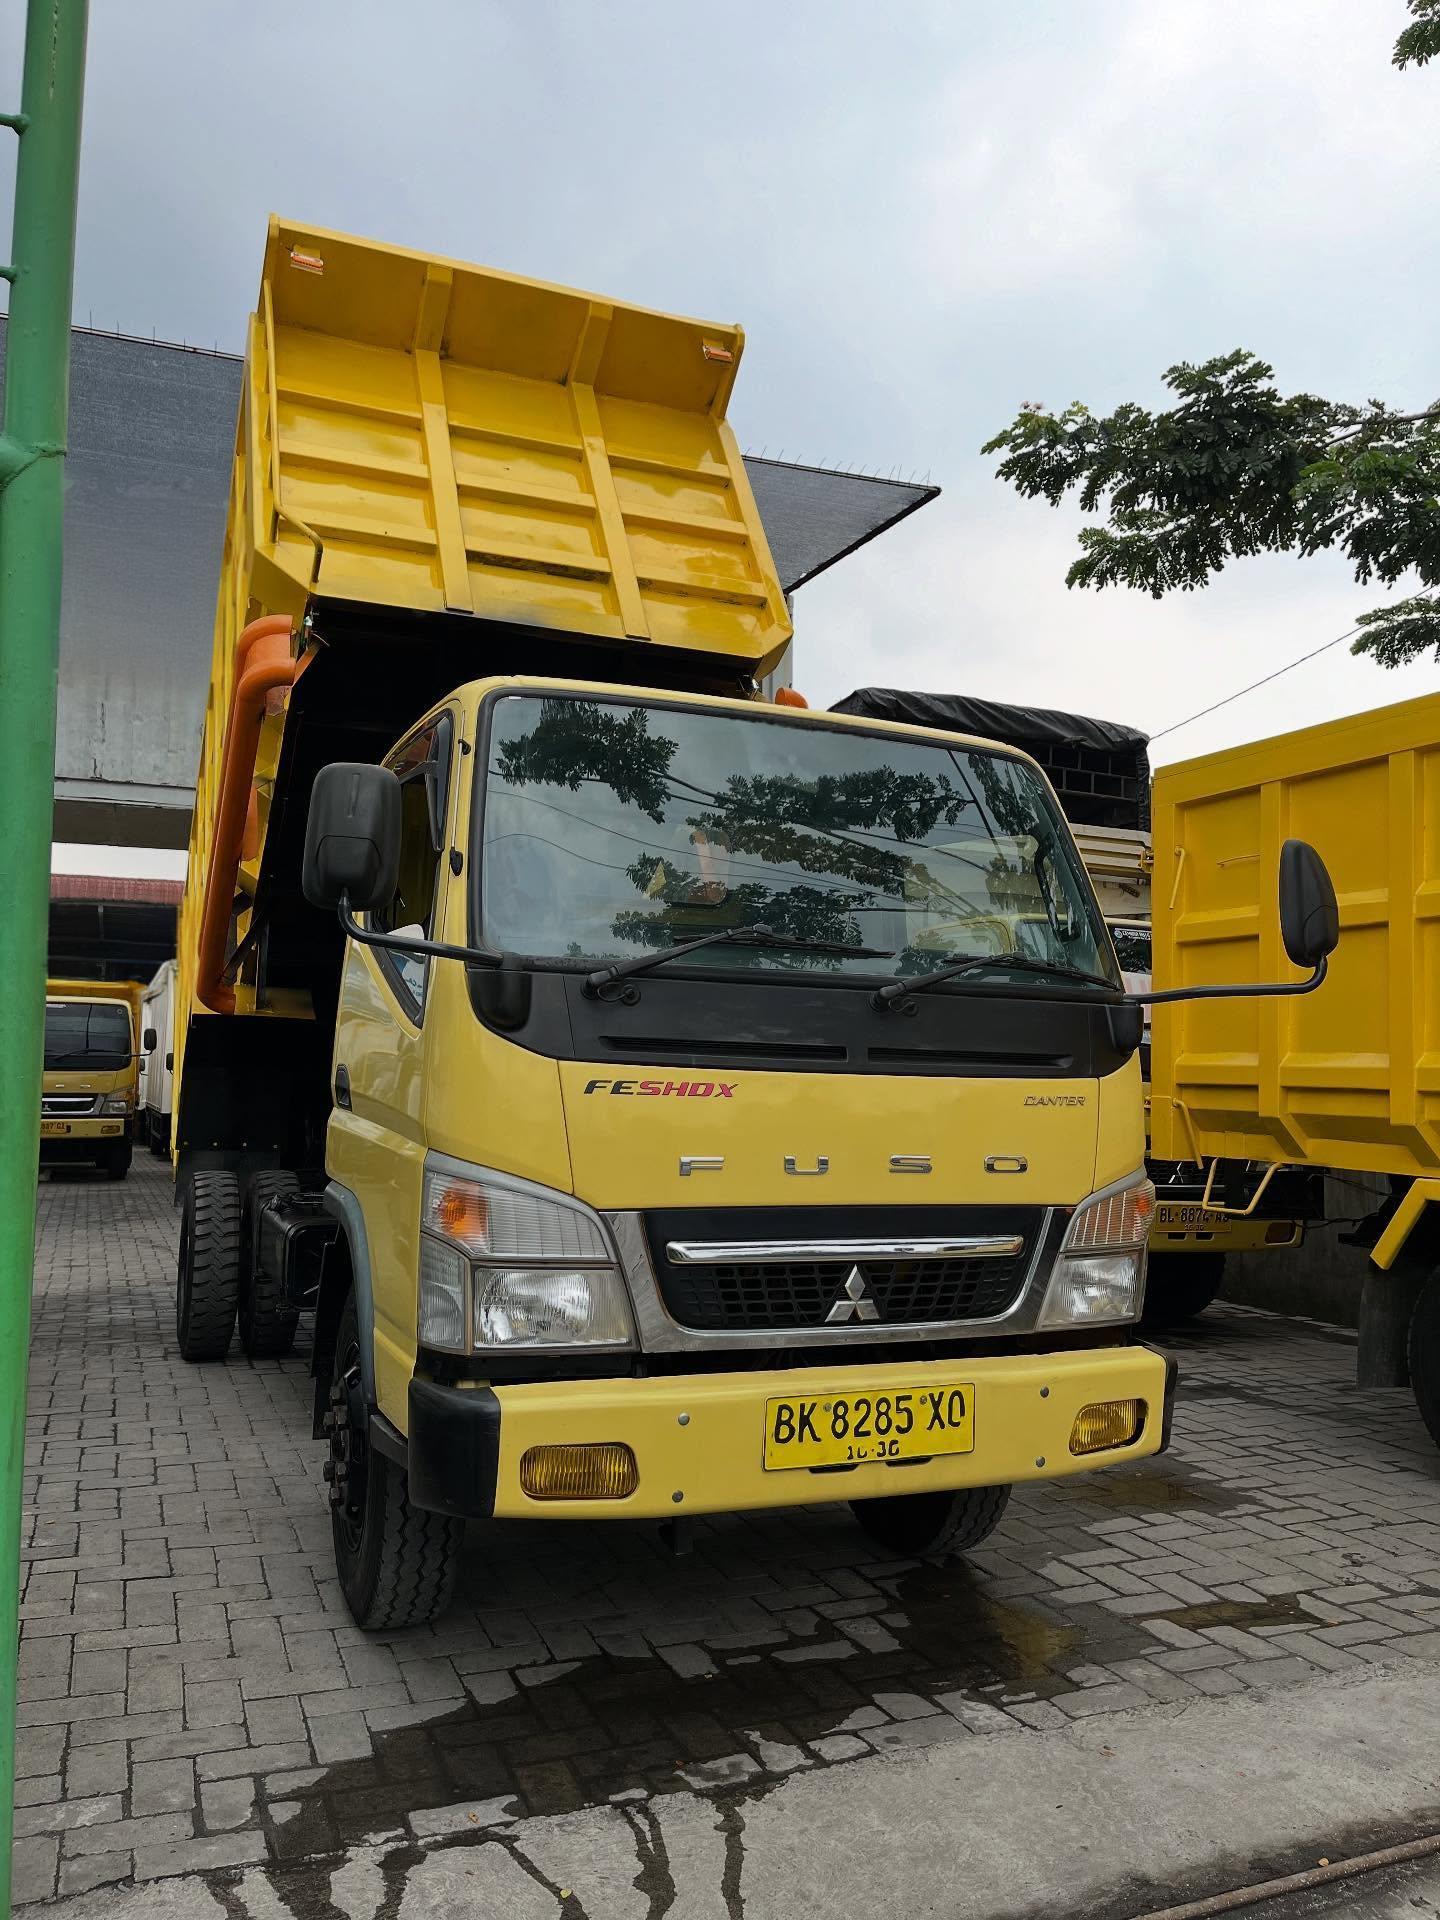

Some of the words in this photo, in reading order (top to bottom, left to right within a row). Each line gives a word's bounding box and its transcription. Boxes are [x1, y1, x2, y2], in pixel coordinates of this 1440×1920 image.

[1023, 1095, 1087, 1106] CANTER
[679, 1154, 1029, 1177] FUSO
[774, 1402, 822, 1444] BK
[831, 1394, 914, 1440] 8285
